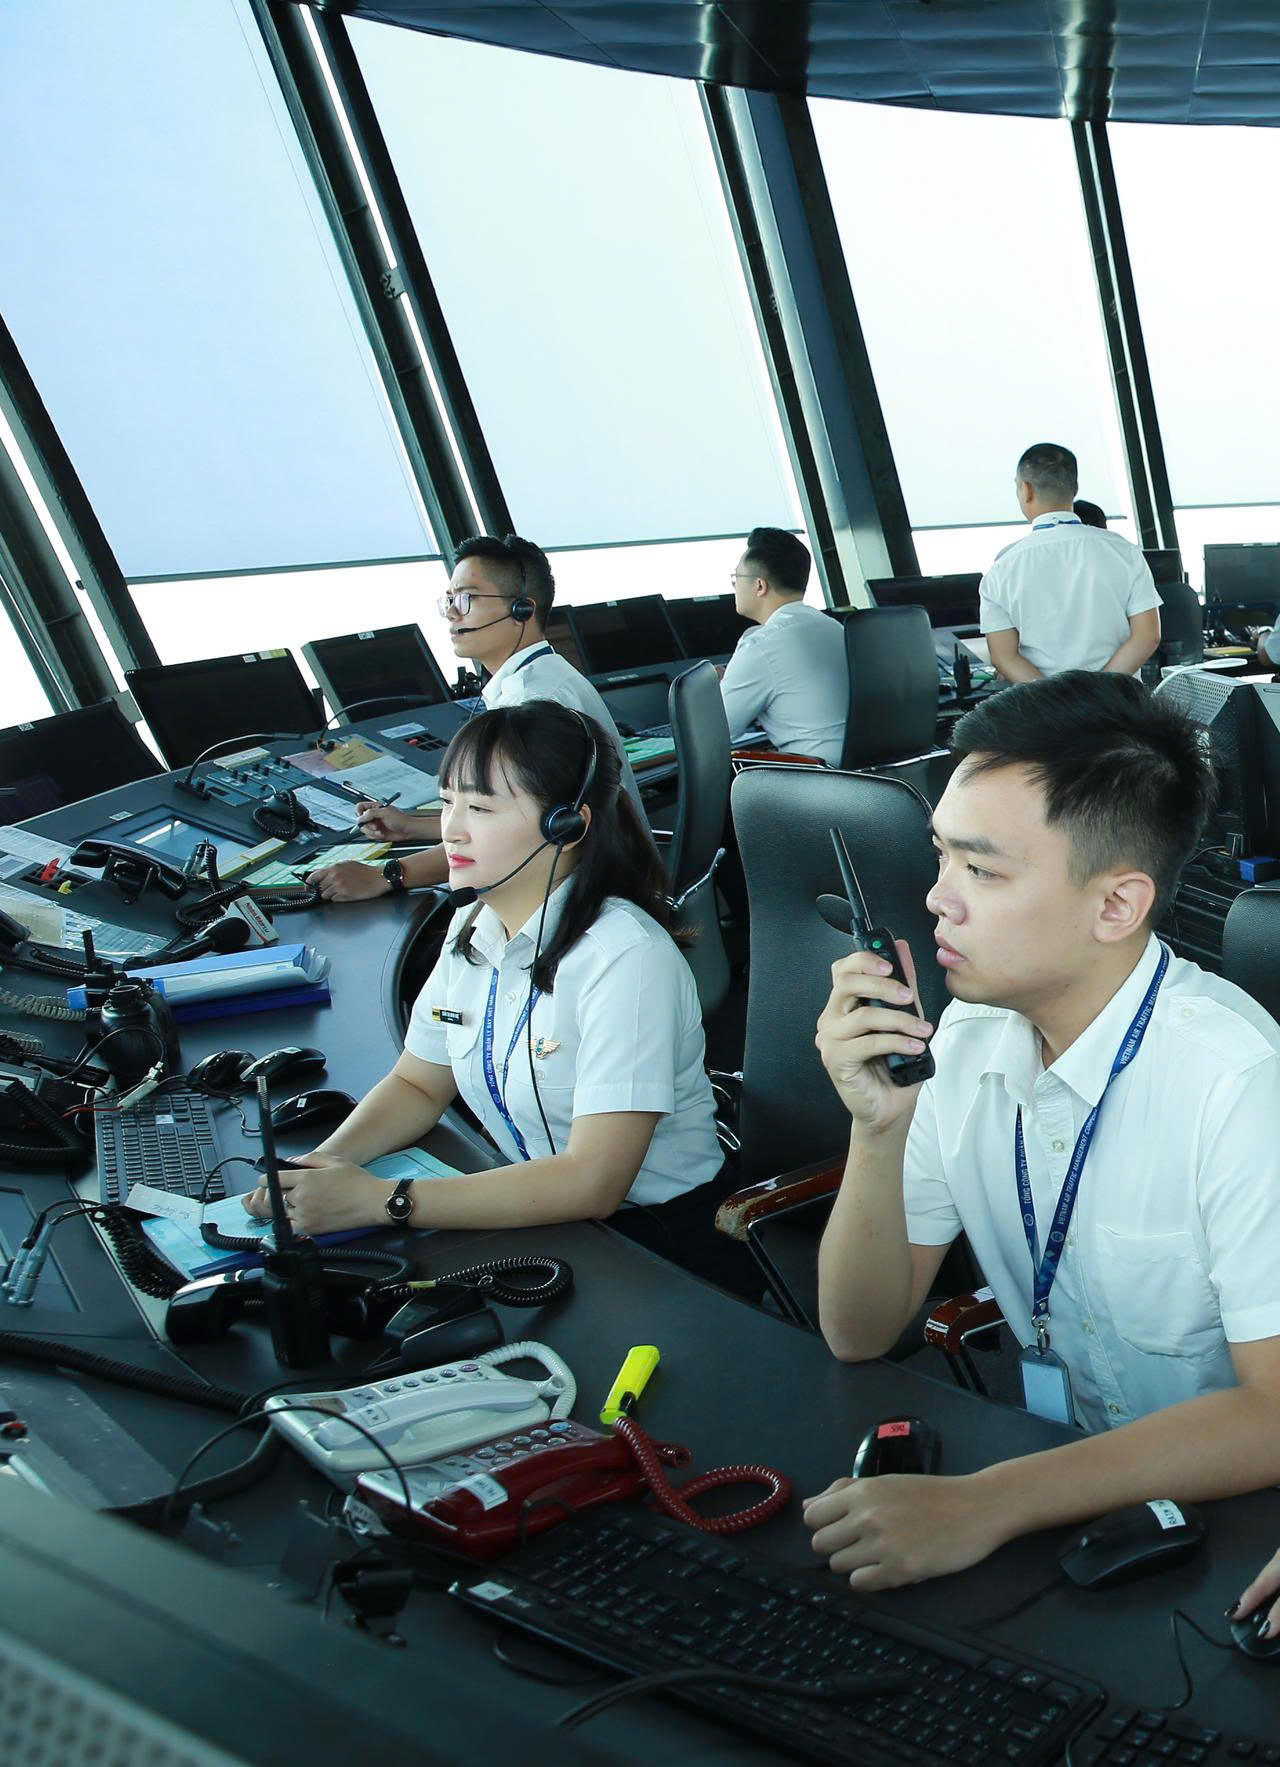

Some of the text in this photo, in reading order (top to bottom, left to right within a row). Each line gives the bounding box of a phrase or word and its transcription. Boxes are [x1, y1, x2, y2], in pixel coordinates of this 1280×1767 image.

[1136, 1005, 1153, 1029] TRAFFIC
[1131, 1028, 1142, 1040] AIR
[1120, 1038, 1137, 1065] VIETNAM
[1072, 1135, 1089, 1171] MANAGEMENT
[1067, 1170, 1078, 1192] TRAFFIC
